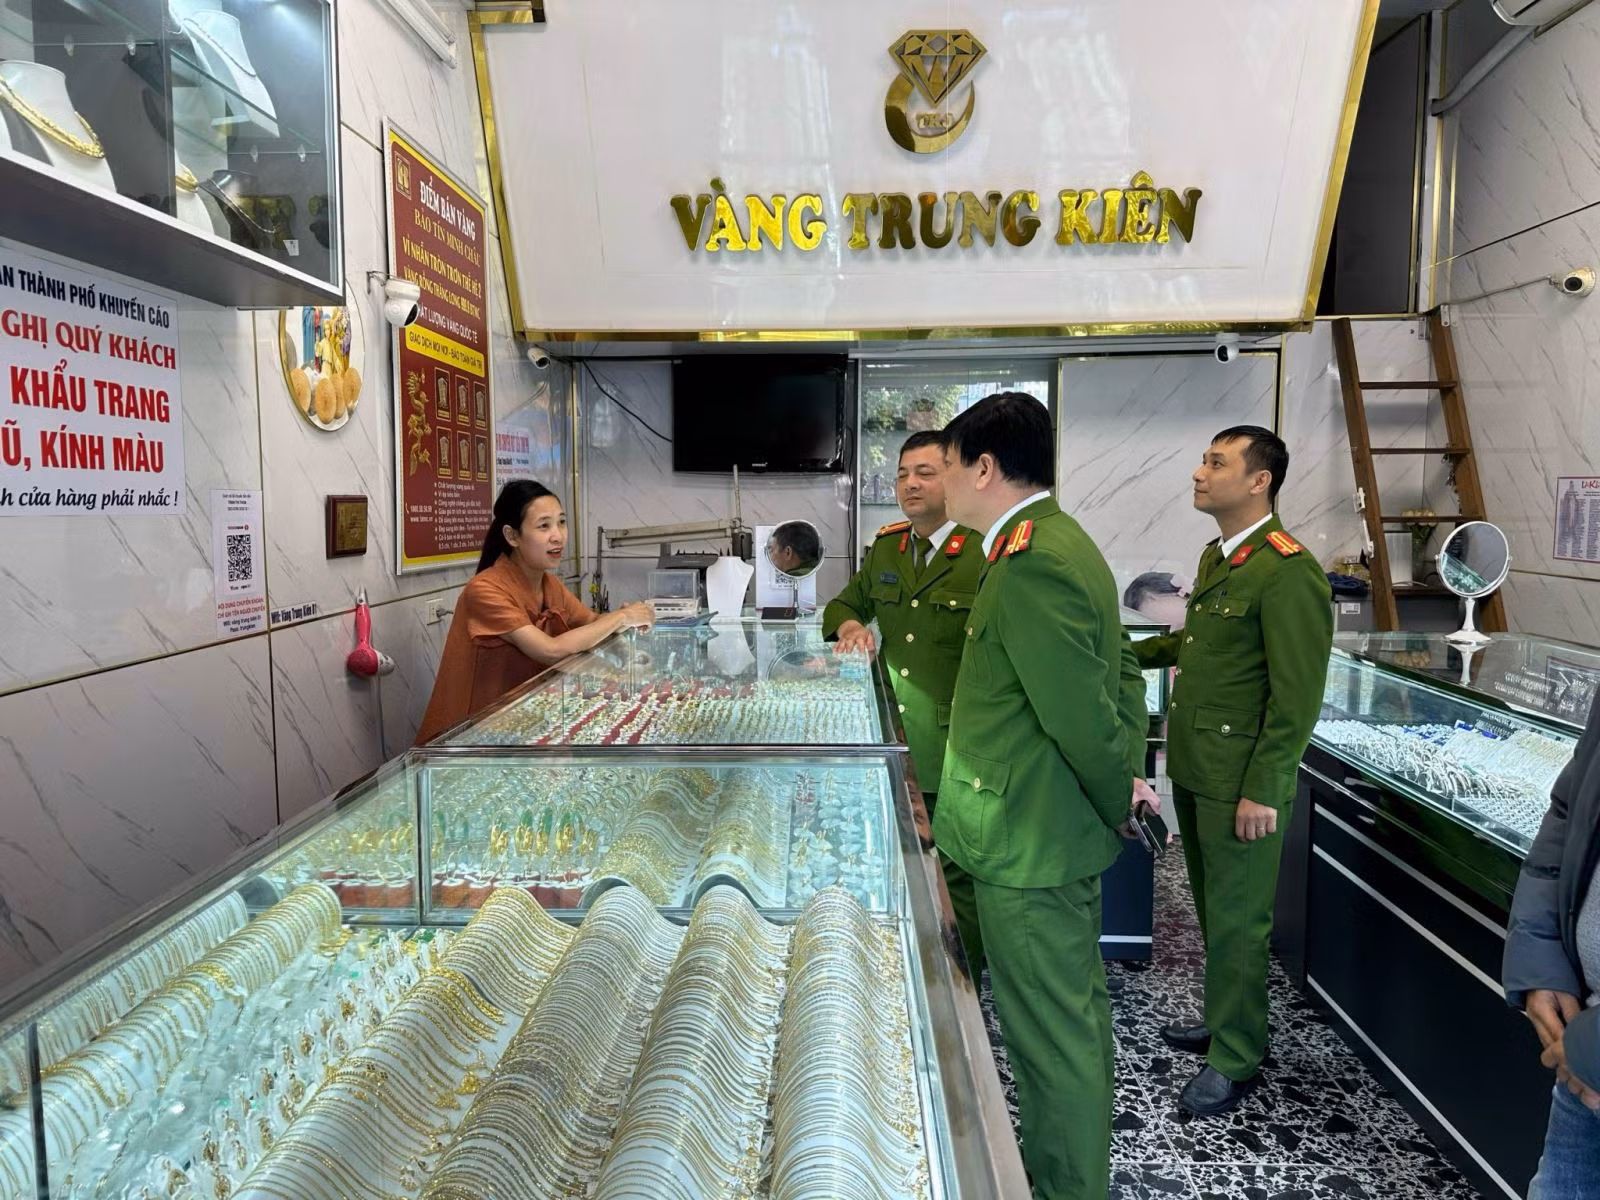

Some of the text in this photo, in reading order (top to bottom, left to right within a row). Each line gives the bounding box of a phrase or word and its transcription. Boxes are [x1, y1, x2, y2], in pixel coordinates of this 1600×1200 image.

[441, 196, 456, 227] BÁN
[457, 208, 476, 241] VÀNG
[669, 170, 1203, 251] VÀNG TRUNG KIÊN
[18, 270, 66, 301] THÀNH
[69, 283, 96, 309] PHỐ
[99, 292, 146, 322] KHUYẾN
[148, 306, 170, 329] CÁO
[55, 324, 103, 354] QUÝ
[109, 336, 177, 370] KHÁCH
[10, 358, 170, 423] KHẨU TRANG
[40, 424, 105, 470] KÍNH
[112, 432, 164, 473] MÀU
[18, 486, 51, 506] cửa
[55, 488, 97, 510] hàng
[101, 489, 135, 510] phải
[138, 488, 170, 506] nhắc
